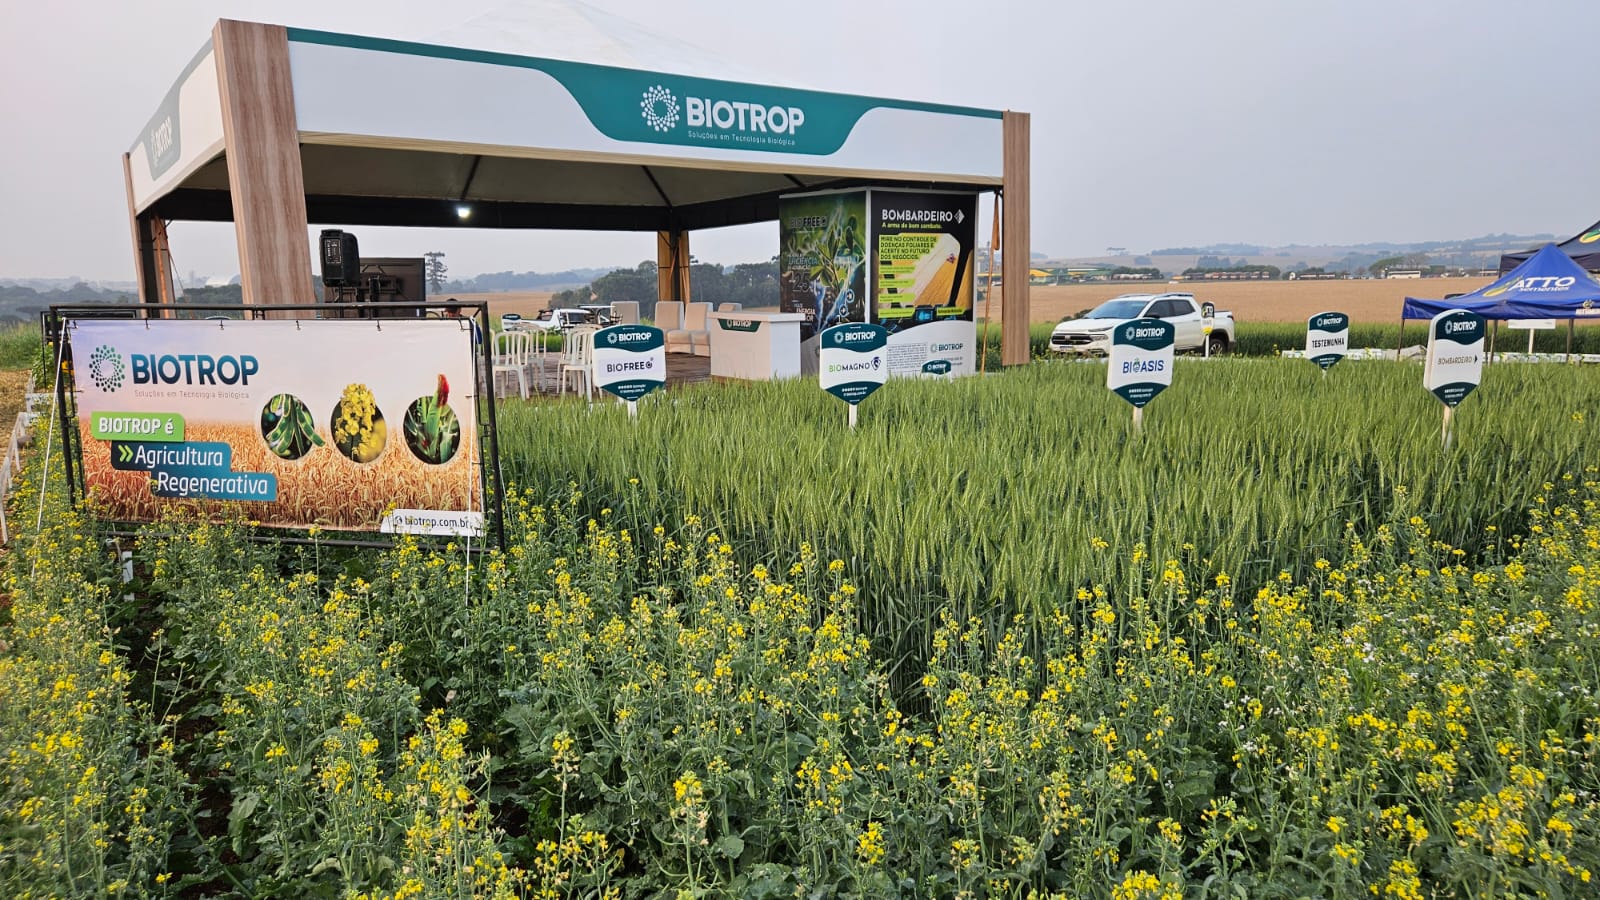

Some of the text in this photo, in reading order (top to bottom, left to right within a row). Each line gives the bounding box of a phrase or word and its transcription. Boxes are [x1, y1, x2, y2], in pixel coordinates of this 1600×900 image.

[686, 96, 805, 135] BIOTROP
[732, 134, 766, 144] Tecnologia
[768, 137, 796, 146] Biológica
[882, 209, 953, 222] BOMBARDEIRO
[1507, 276, 1576, 291] ATTO
[1453, 321, 1477, 332] BIOTROP
[618, 332, 652, 342] BIOTROP
[845, 331, 876, 341] BIOTROP
[1136, 328, 1165, 338] BIOTROP
[938, 343, 965, 351] BIOTROP
[1312, 338, 1345, 348] TESTEMUNHA
[1438, 356, 1472, 365] BOMBARDEIRO
[131, 354, 259, 386] BIOTROP
[607, 361, 645, 372] BIOFREE
[829, 362, 870, 373] BIOMAGNO
[134, 389, 164, 398] Soluções
[180, 390, 216, 399] Tecnologia
[218, 391, 250, 400] Biológica
[99, 417, 175, 434] BIOTROP é
[135, 445, 224, 469] Agricultura
[158, 472, 269, 497] Regenerativa
[405, 516, 469, 529] biotrop.com.br
